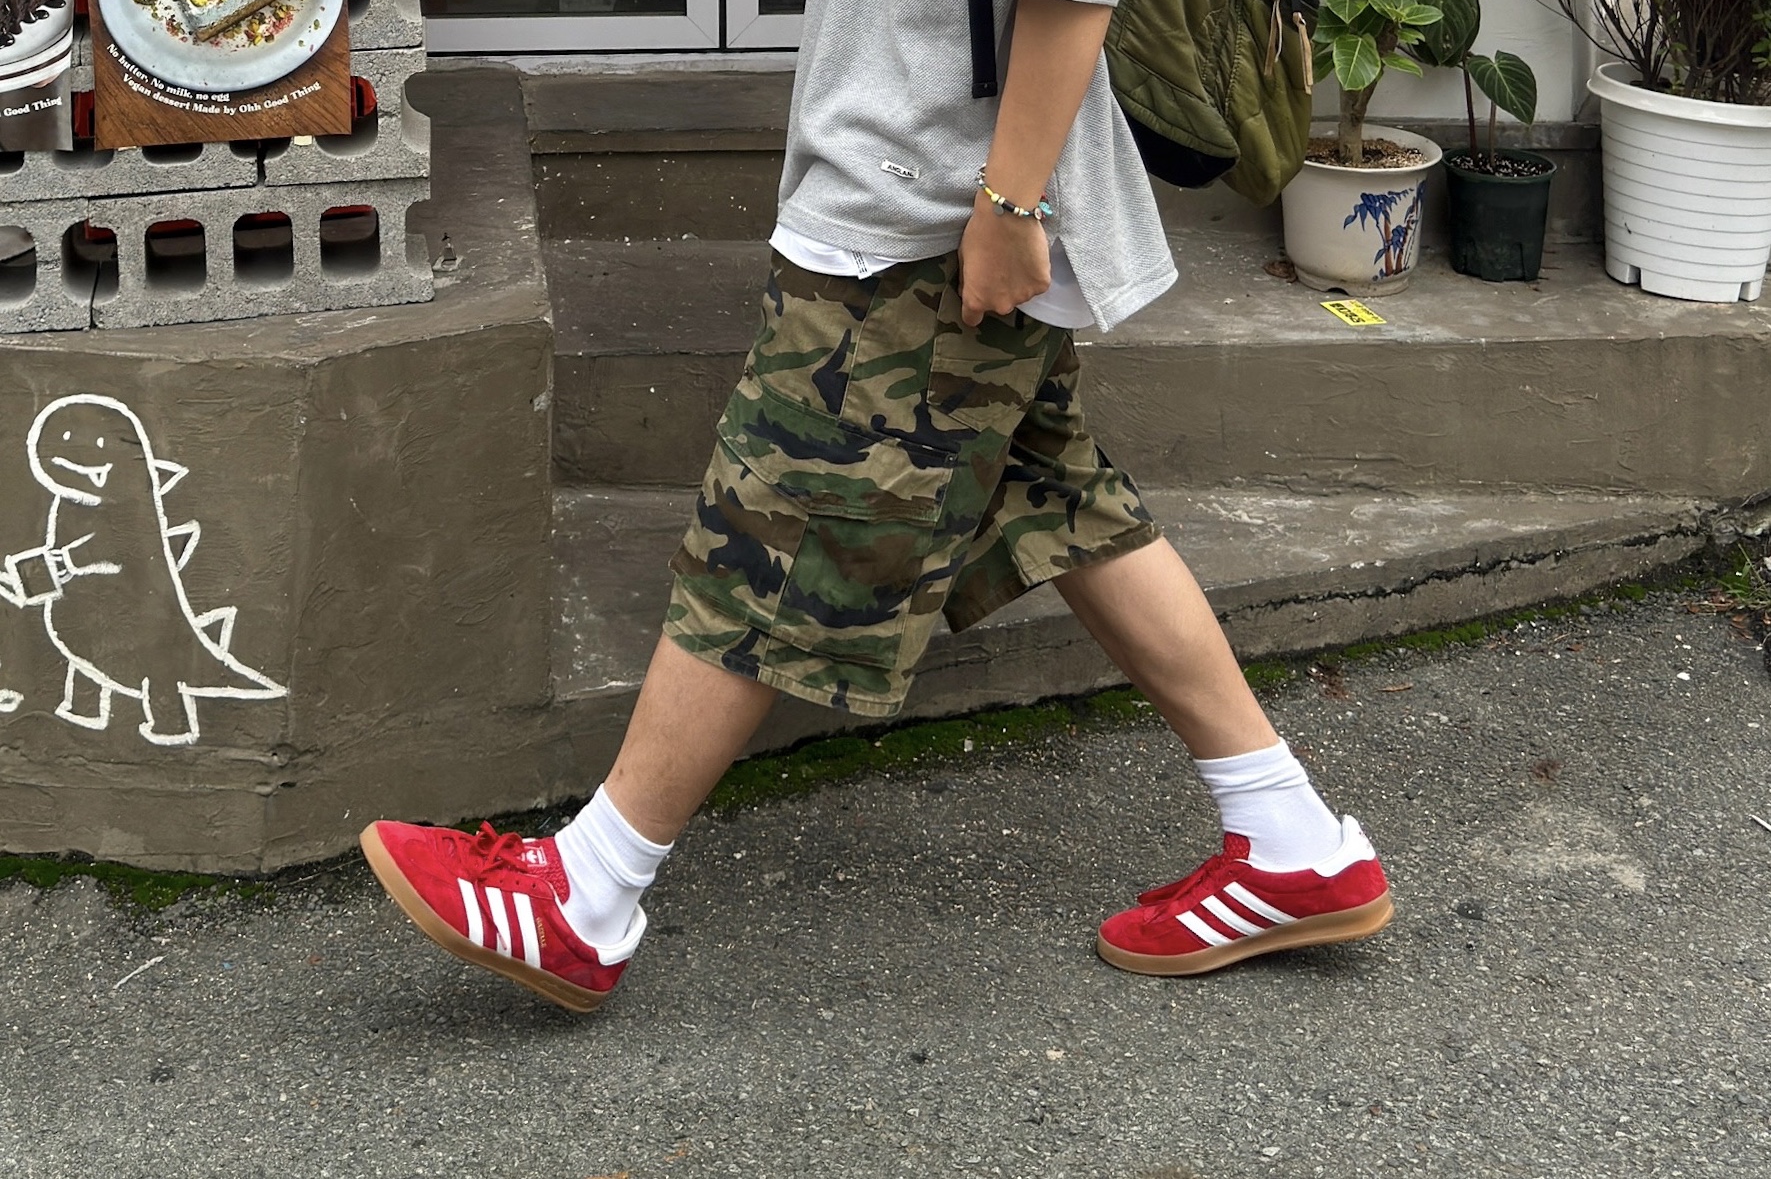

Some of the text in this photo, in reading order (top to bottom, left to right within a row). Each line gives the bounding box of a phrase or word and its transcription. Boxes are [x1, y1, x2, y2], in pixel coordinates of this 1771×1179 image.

[106, 43, 119, 58] No
[118, 55, 149, 83] butter,
[150, 77, 165, 90] No
[195, 93, 209, 101] no
[210, 93, 231, 102] egg
[3, 96, 63, 117] Good Thing
[123, 73, 322, 116] Vegan dessert Made by Ohh Good Thing
